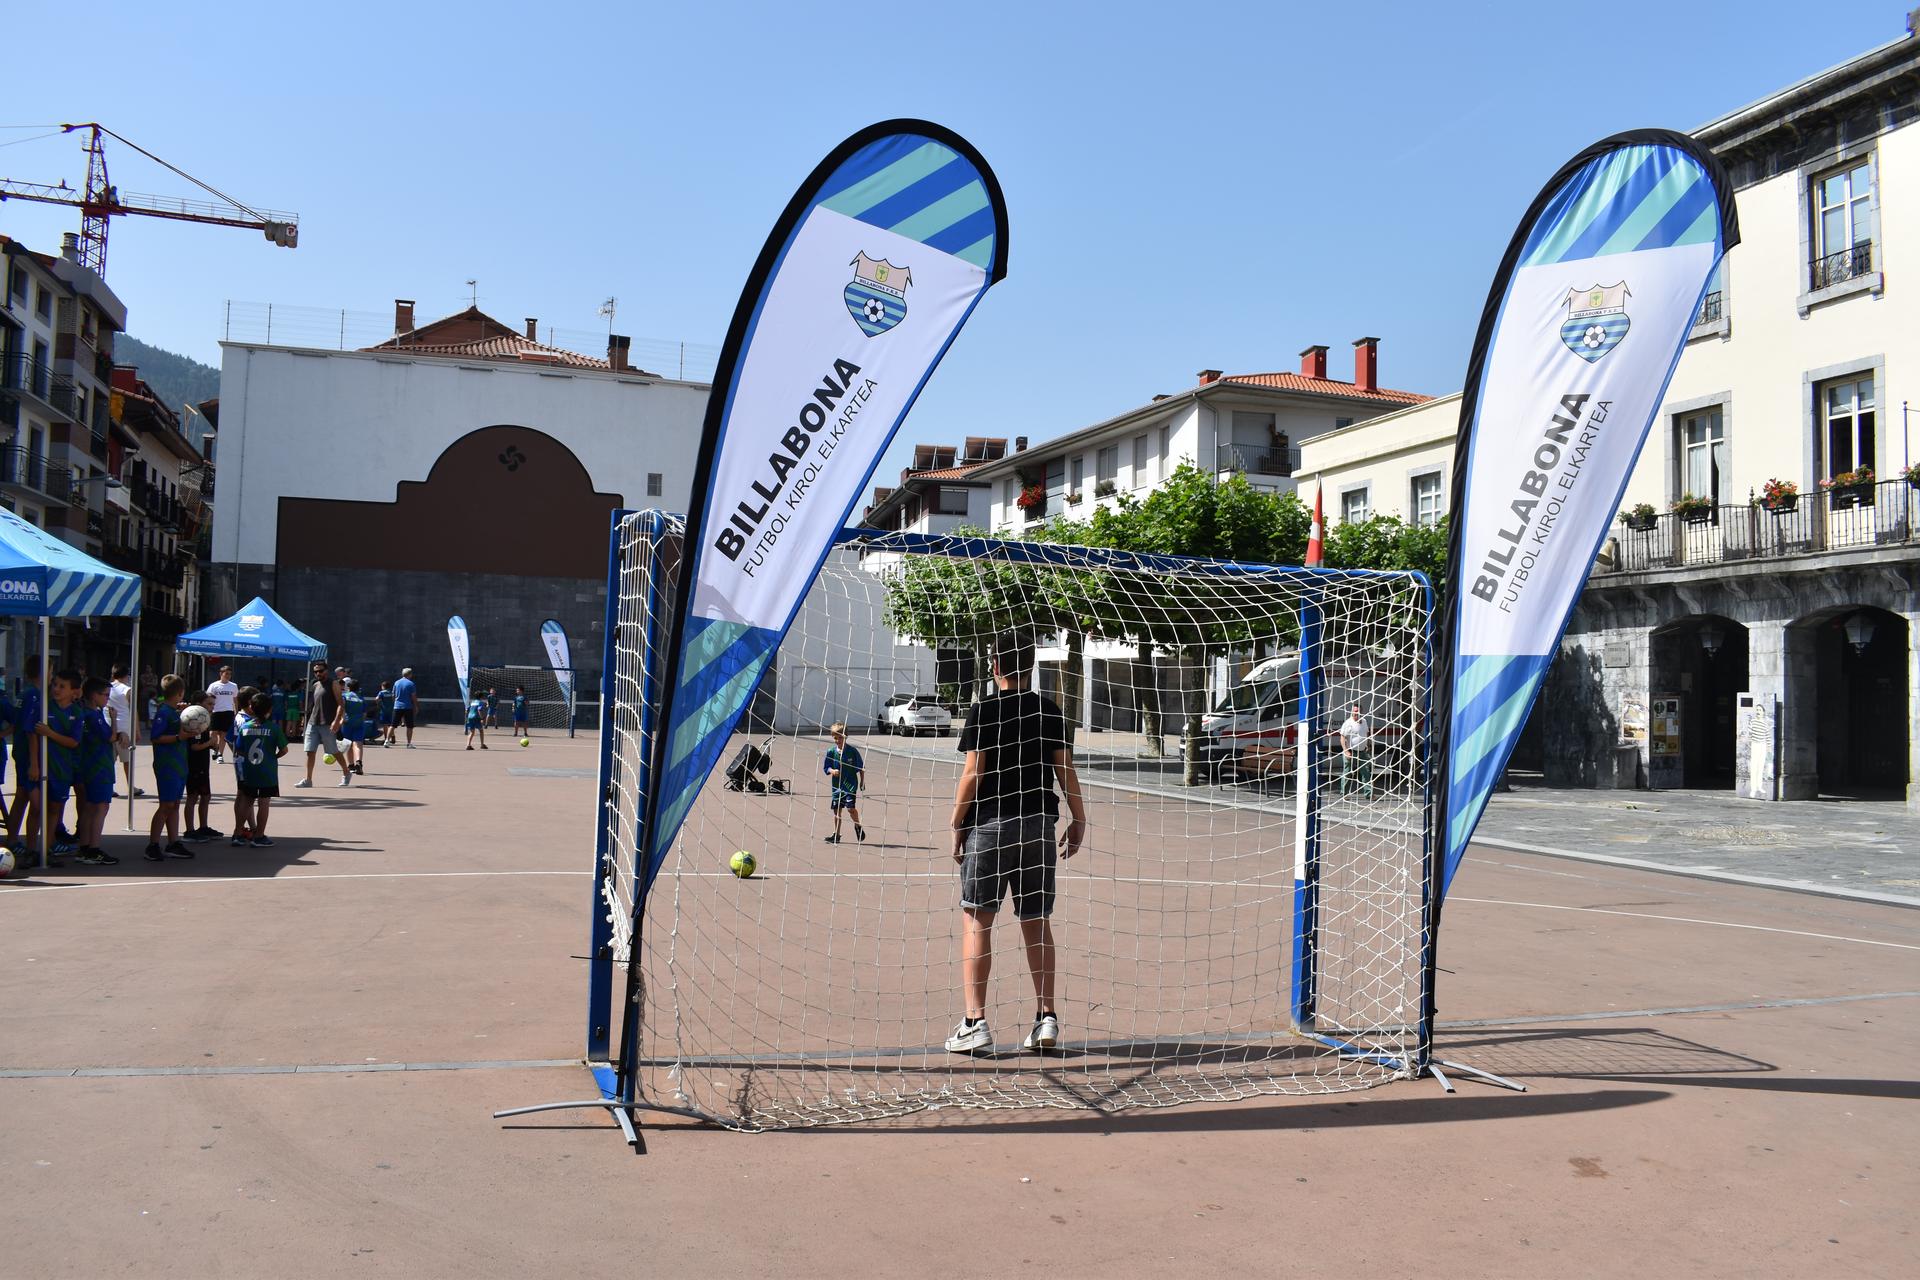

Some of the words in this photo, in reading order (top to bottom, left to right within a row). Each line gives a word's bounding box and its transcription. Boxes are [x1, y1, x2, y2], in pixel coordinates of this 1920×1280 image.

[714, 358, 861, 562] BILLABONA
[743, 512, 791, 577] FUTBOL
[785, 461, 823, 510] KIROL
[818, 378, 878, 460] ELKARTEA
[1471, 393, 1591, 603] BILLABONA
[1499, 549, 1541, 613] FUTBOL
[1532, 494, 1567, 544] KIROL
[1558, 399, 1614, 490] ELKARTEA
[0, 580, 40, 594] ONA
[248, 738, 264, 765] 6
